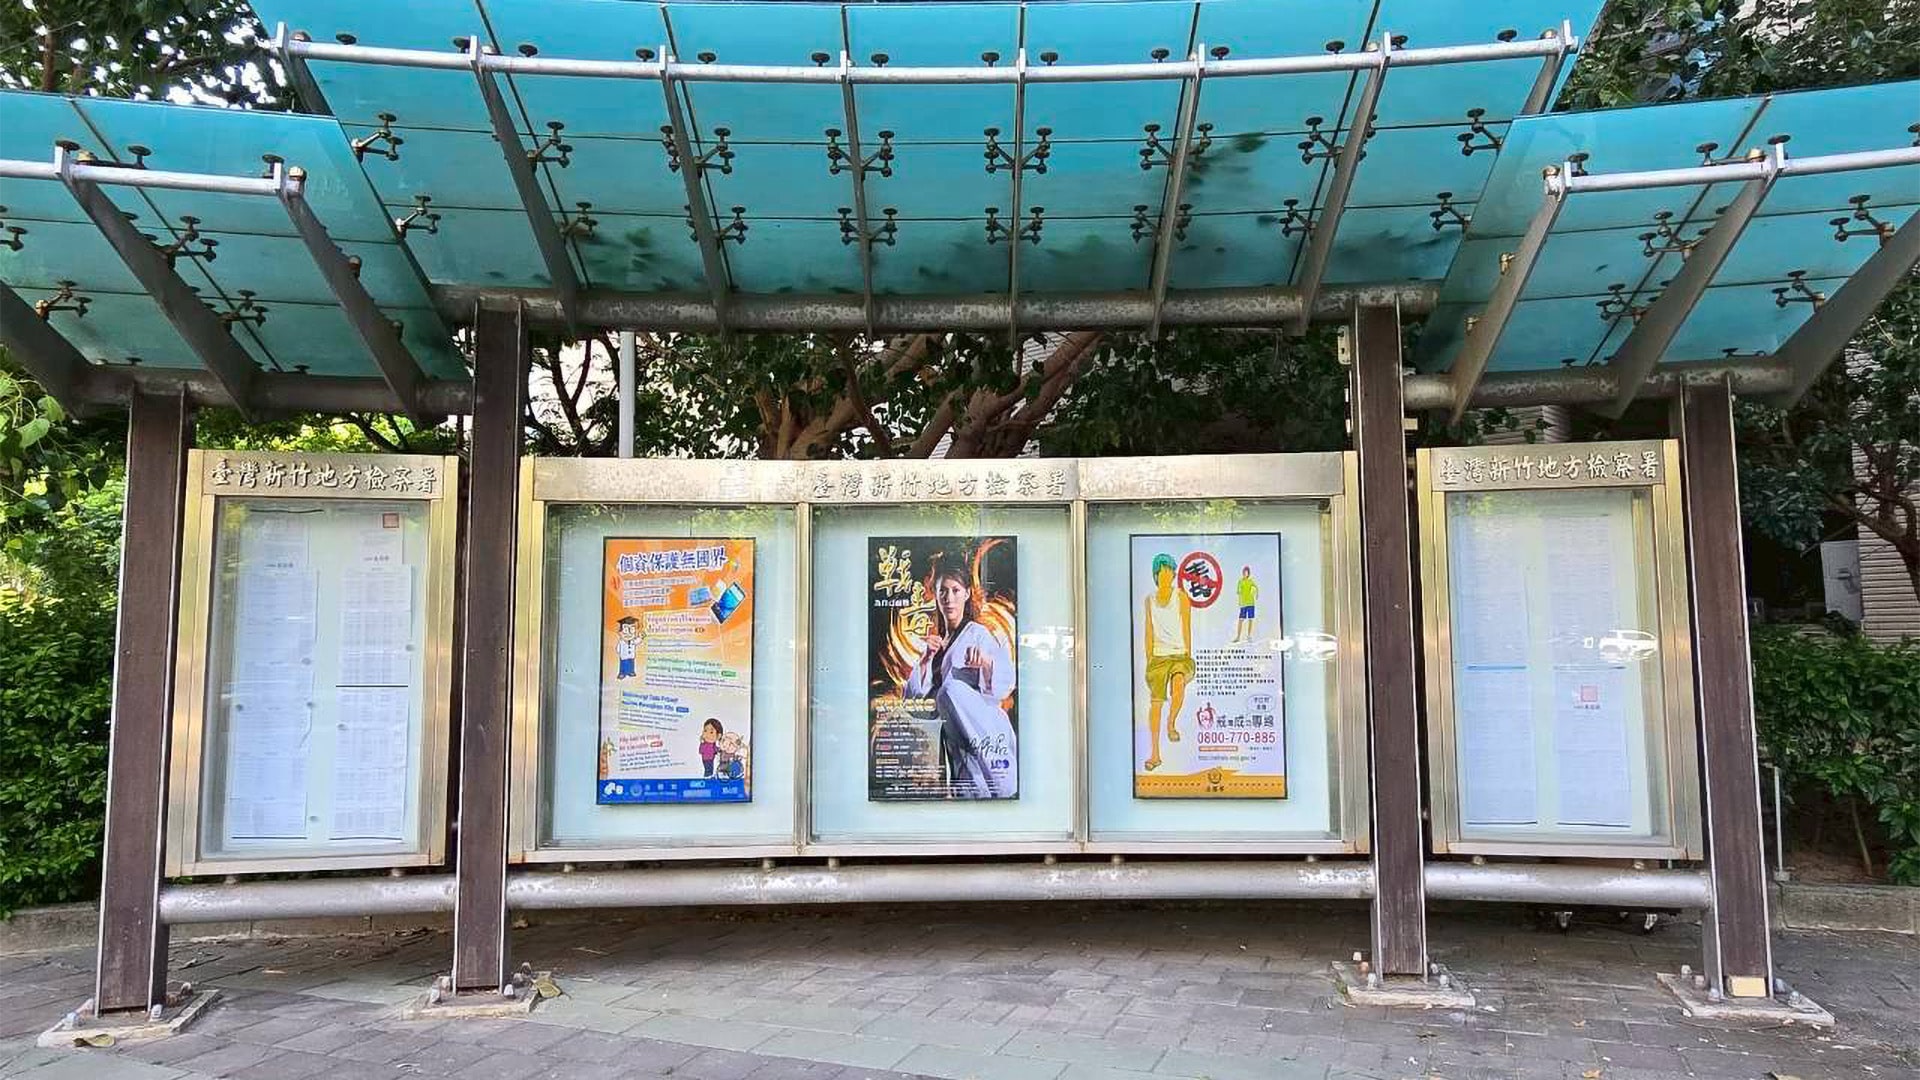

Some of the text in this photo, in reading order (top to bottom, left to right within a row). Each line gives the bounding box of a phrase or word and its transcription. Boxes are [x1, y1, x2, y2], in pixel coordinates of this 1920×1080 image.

[211, 458, 437, 494] 臺灣新竹地方檢察署
[813, 468, 1067, 499] 臺灣新竹地方檢察署
[1438, 450, 1660, 486] 臺灣新竹地方檢察署
[619, 547, 727, 573] 個資保護無國界
[1197, 731, 1276, 744] 0800-770-885
